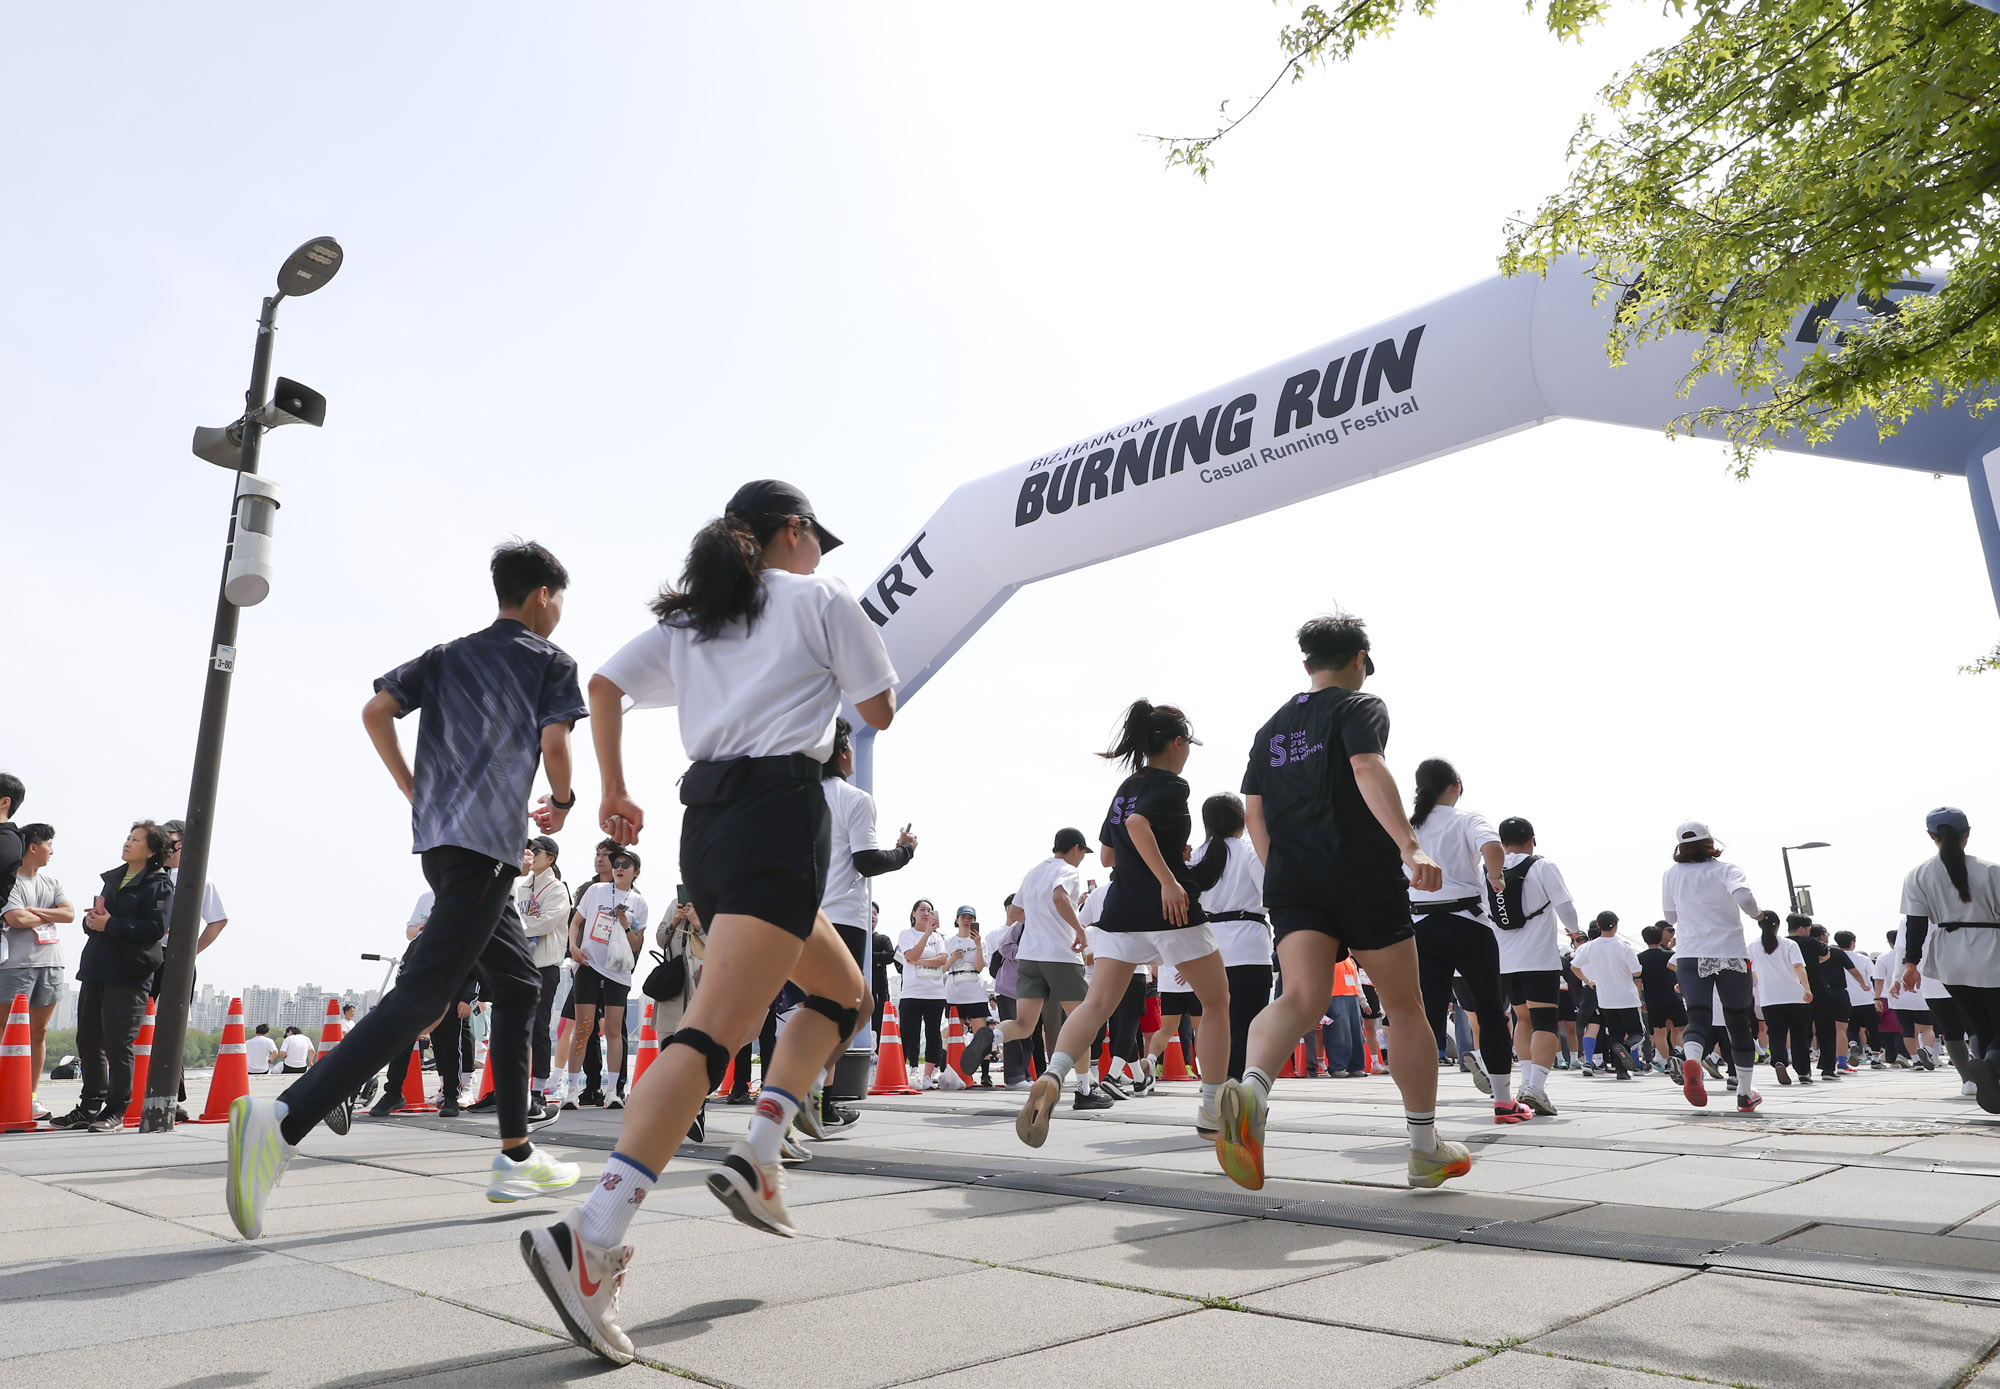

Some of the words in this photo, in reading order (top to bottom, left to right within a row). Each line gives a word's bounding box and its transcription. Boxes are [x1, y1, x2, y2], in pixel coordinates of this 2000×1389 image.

[1015, 393, 1257, 528] BURNING
[1274, 324, 1427, 438] RUN
[1028, 415, 1158, 471] BIZ.HANKOOK
[1200, 453, 1258, 483] Casual
[1260, 428, 1339, 464] Running
[1340, 395, 1419, 436] Festival
